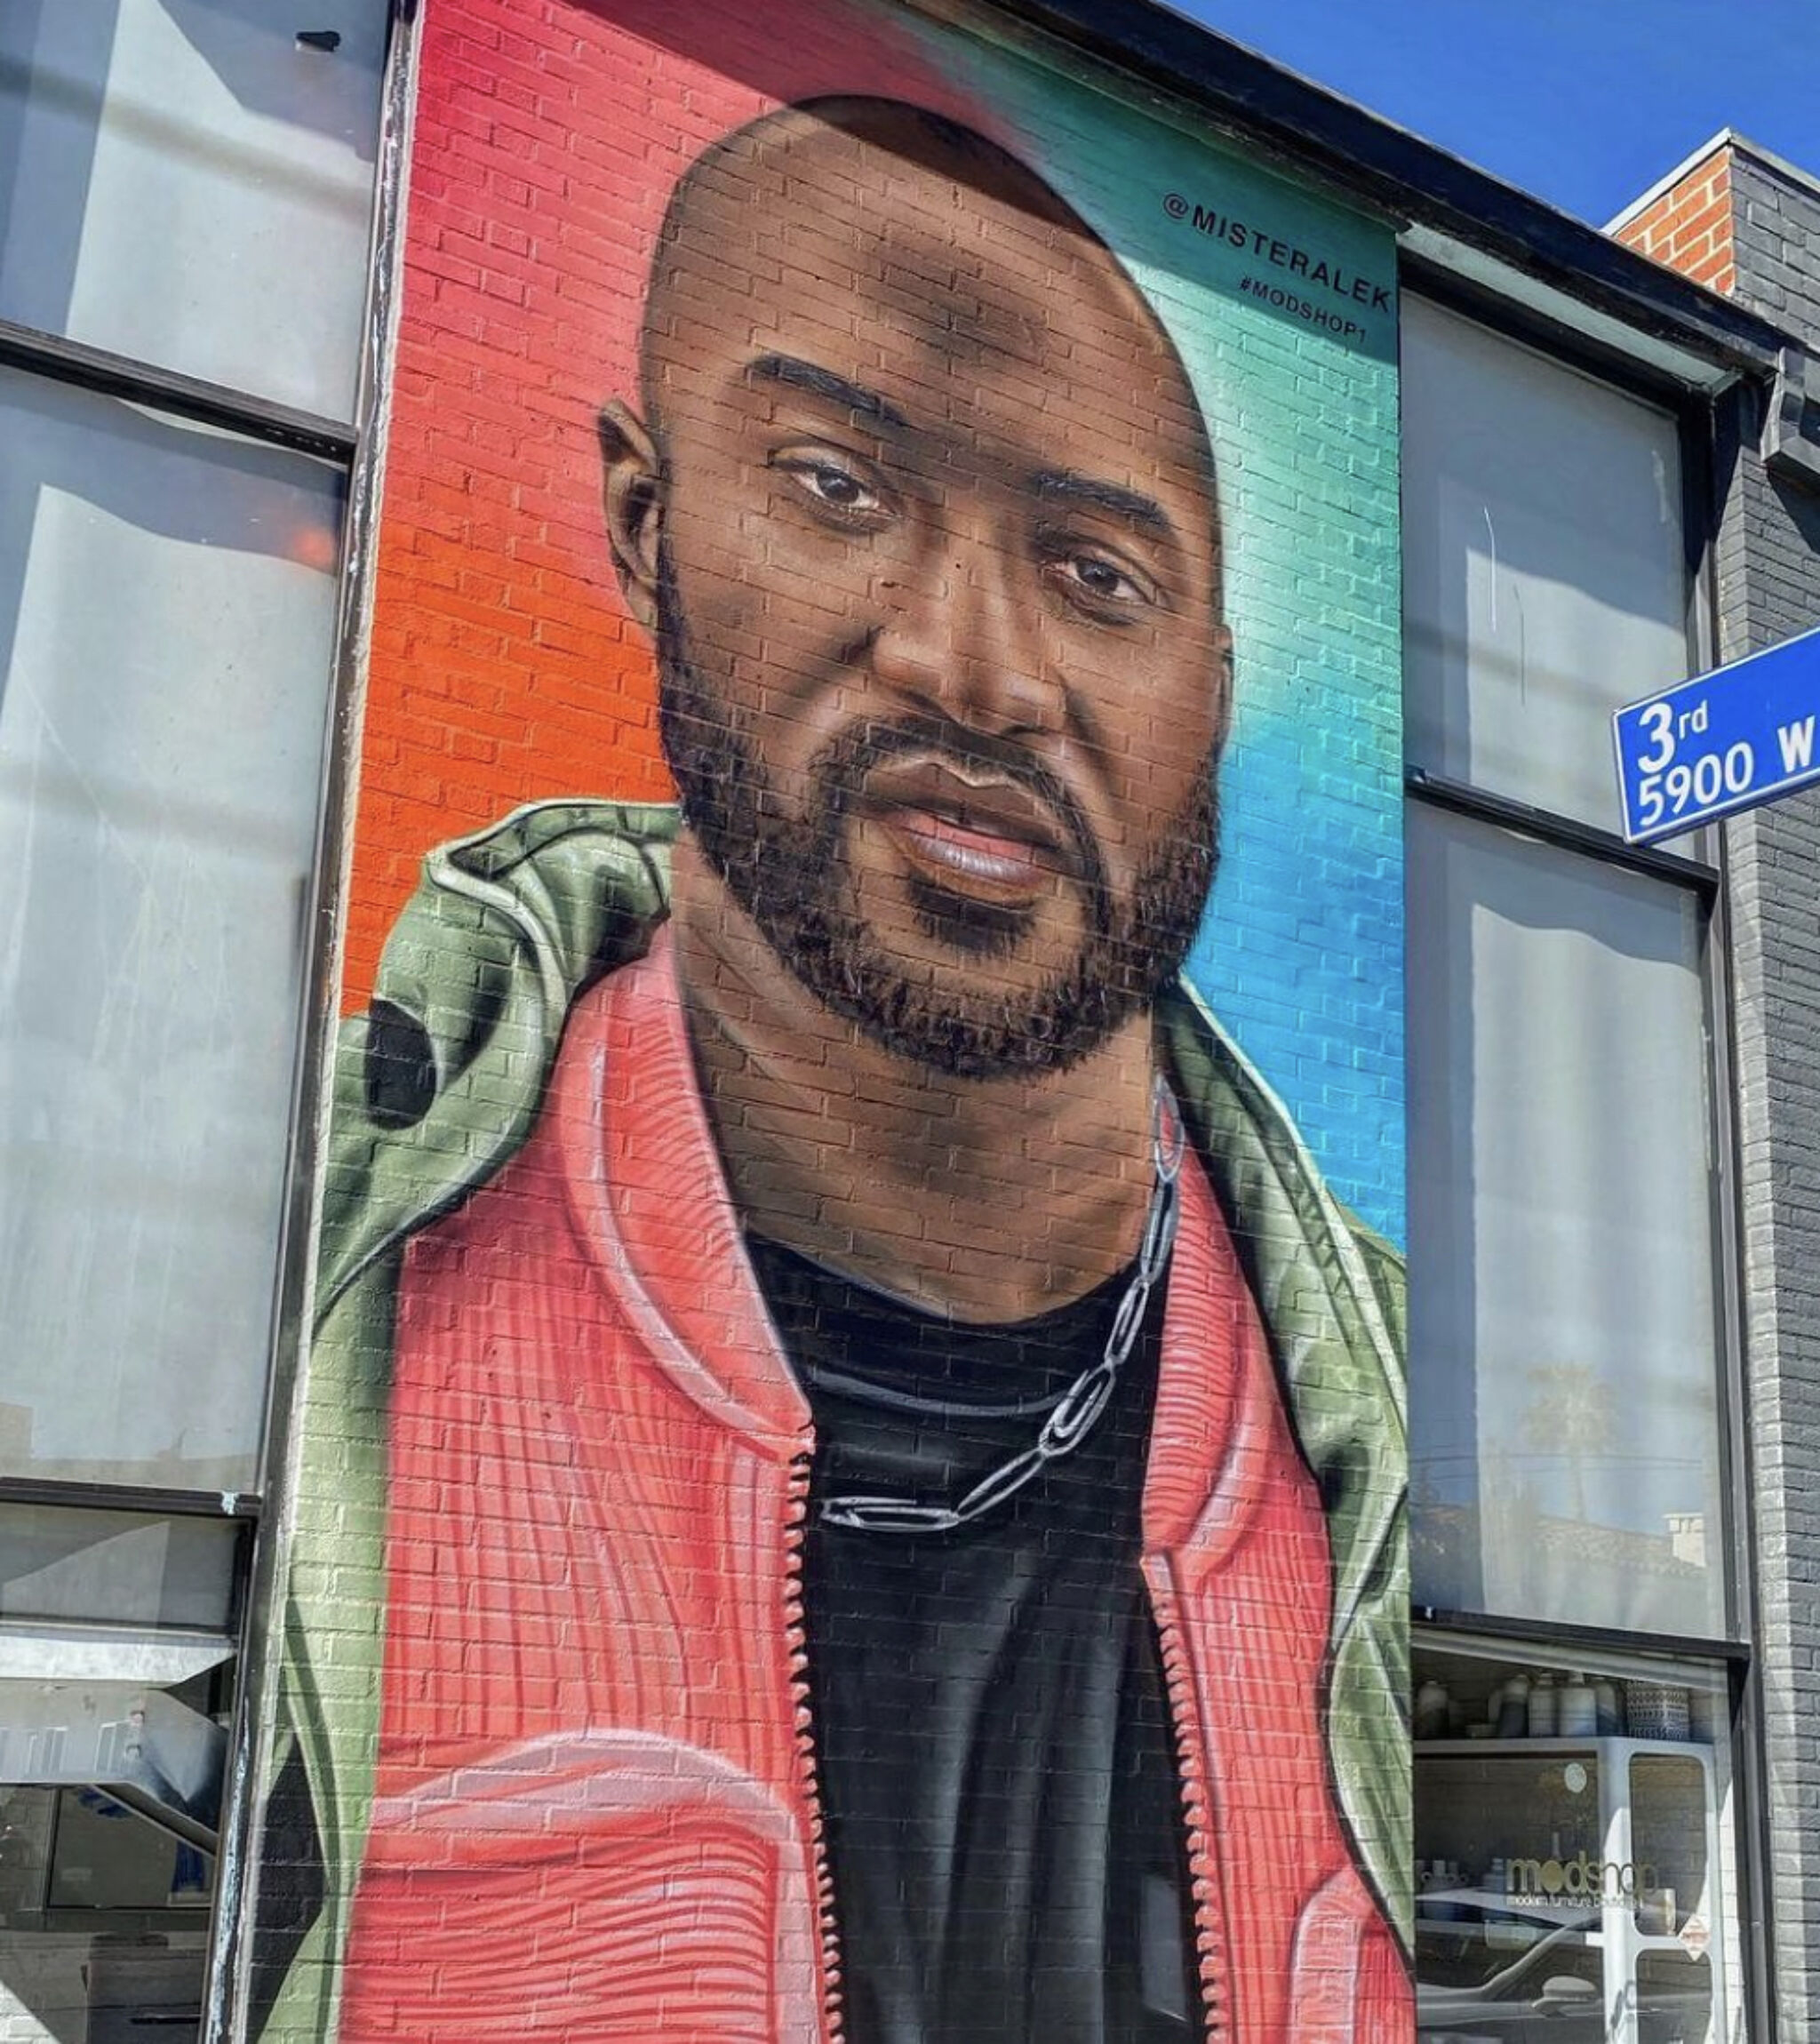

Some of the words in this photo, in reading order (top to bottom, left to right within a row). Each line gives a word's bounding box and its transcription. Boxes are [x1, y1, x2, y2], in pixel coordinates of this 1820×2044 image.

[1163, 194, 1390, 313] @MISTERALEK
[1240, 275, 1366, 343] #MODSHOP1
[1638, 699, 1707, 773] 3rd
[1640, 742, 1754, 826] 5900
[1777, 715, 1815, 773] W
